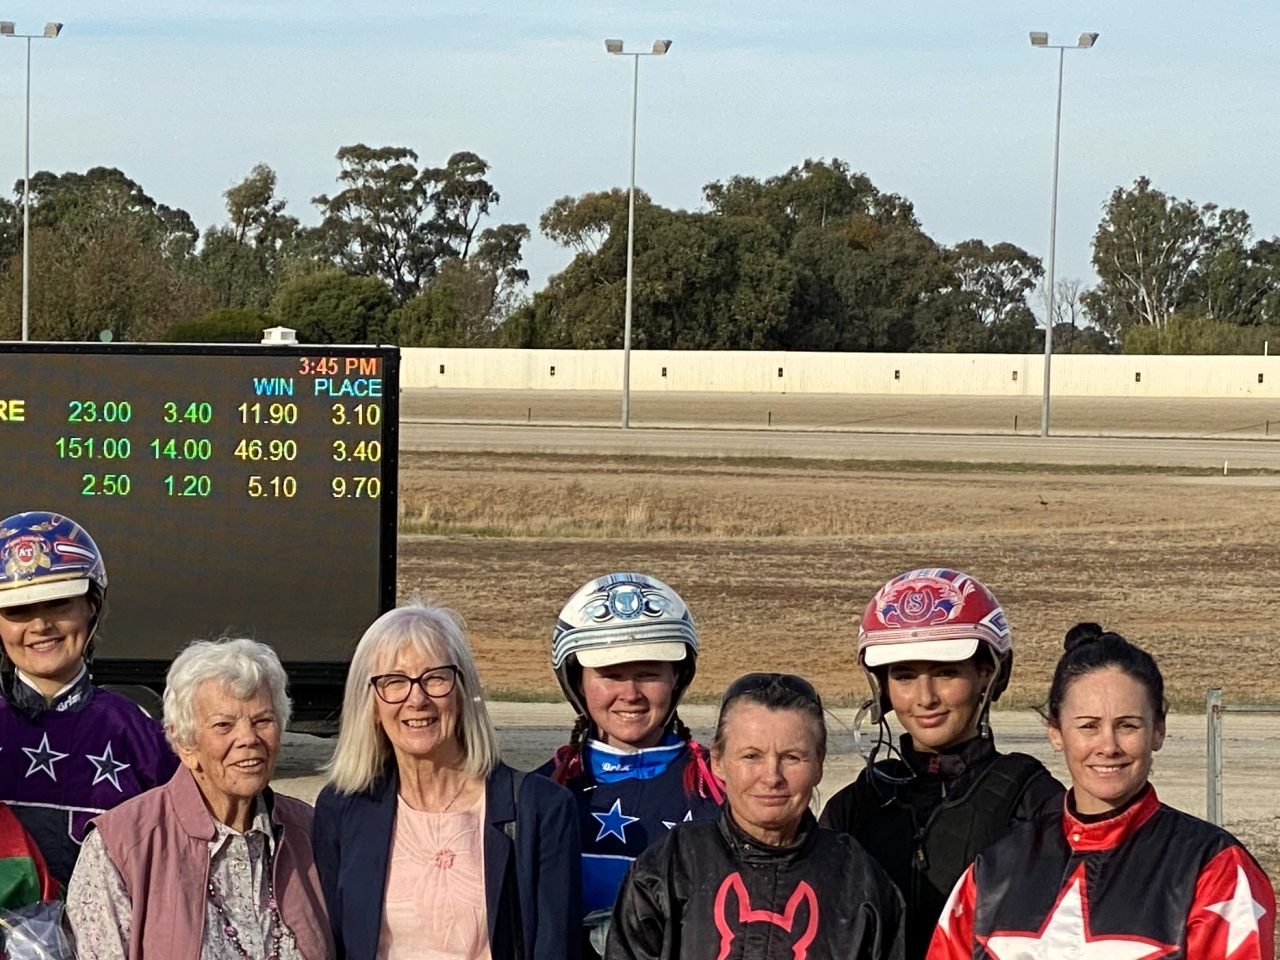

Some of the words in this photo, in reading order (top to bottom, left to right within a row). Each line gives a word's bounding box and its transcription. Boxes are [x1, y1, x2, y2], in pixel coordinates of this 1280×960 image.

[299, 357, 339, 375] 3:45
[345, 358, 377, 376] PM
[253, 378, 294, 396] WIN
[314, 379, 383, 397] PLACE
[68, 401, 132, 422] 23.00
[164, 402, 212, 423] 3.40
[238, 403, 298, 424] 11.90
[331, 404, 381, 425] 3.10
[55, 438, 131, 458] 151.00
[150, 439, 212, 460] 14.00
[233, 439, 297, 460] 46.90
[332, 440, 382, 461] 3.40
[81, 475, 131, 495] 2.50
[164, 476, 211, 496] 1.20
[248, 476, 297, 497] 5.10
[331, 477, 381, 498] 9.70
